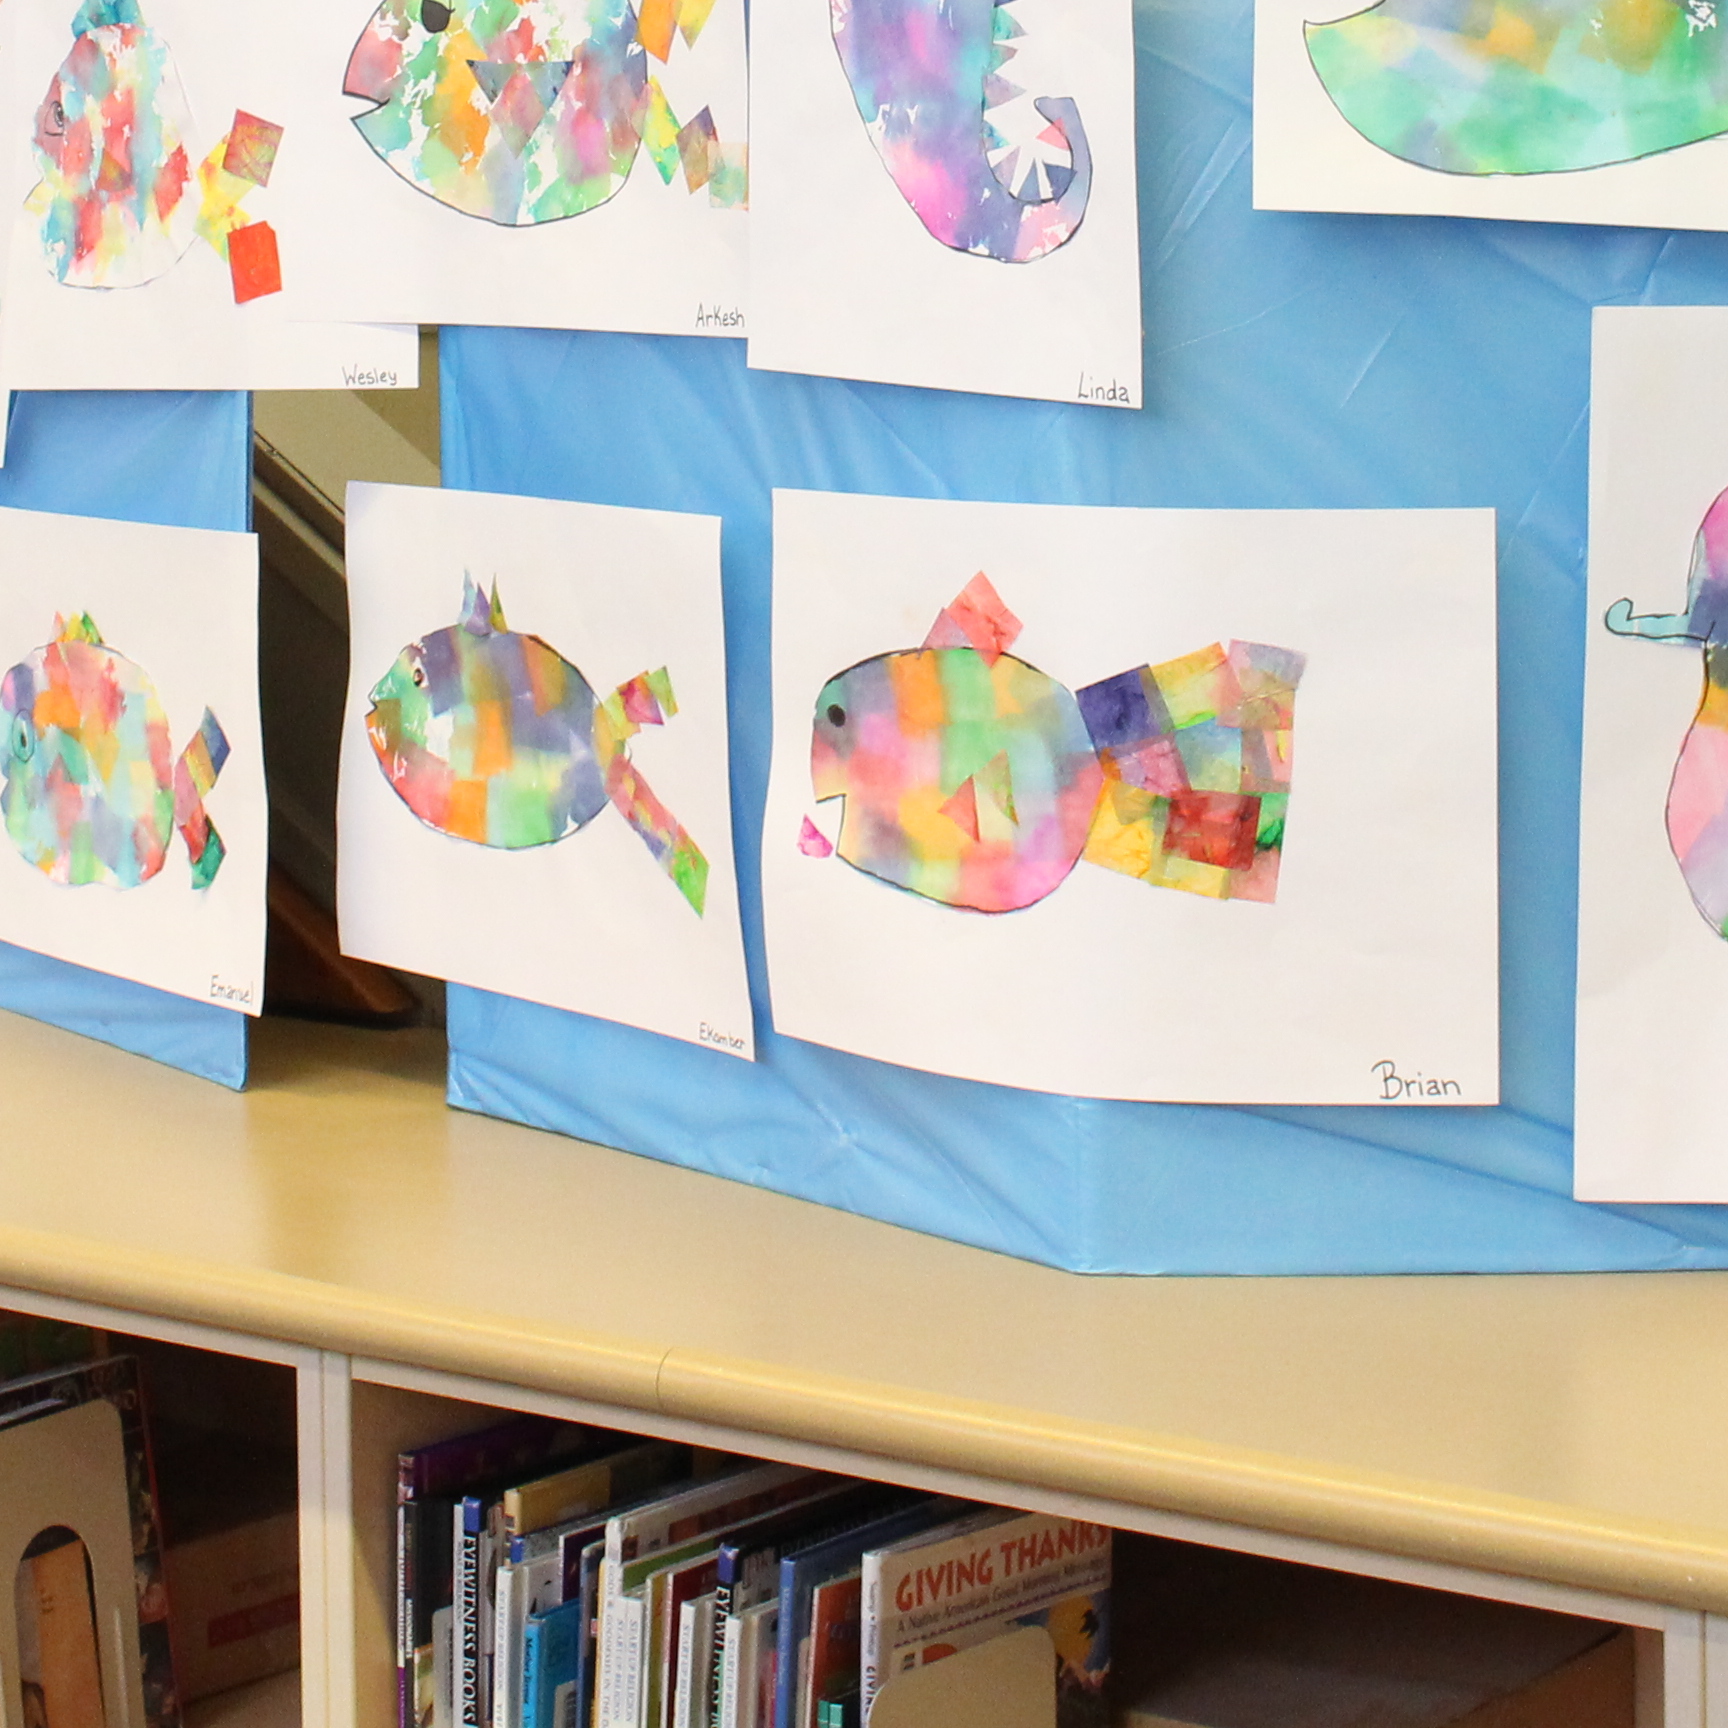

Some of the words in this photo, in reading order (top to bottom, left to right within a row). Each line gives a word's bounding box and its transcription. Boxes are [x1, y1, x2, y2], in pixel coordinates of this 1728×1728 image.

[341, 365, 398, 387] Wesley
[1077, 372, 1131, 405] Linda
[1370, 1060, 1461, 1099] Brian
[896, 1549, 993, 1612] GIVING
[1000, 1521, 1108, 1578] THANKS
[463, 1536, 477, 1651] EYEWITNESS
[463, 1656, 476, 1721] BOOKS
